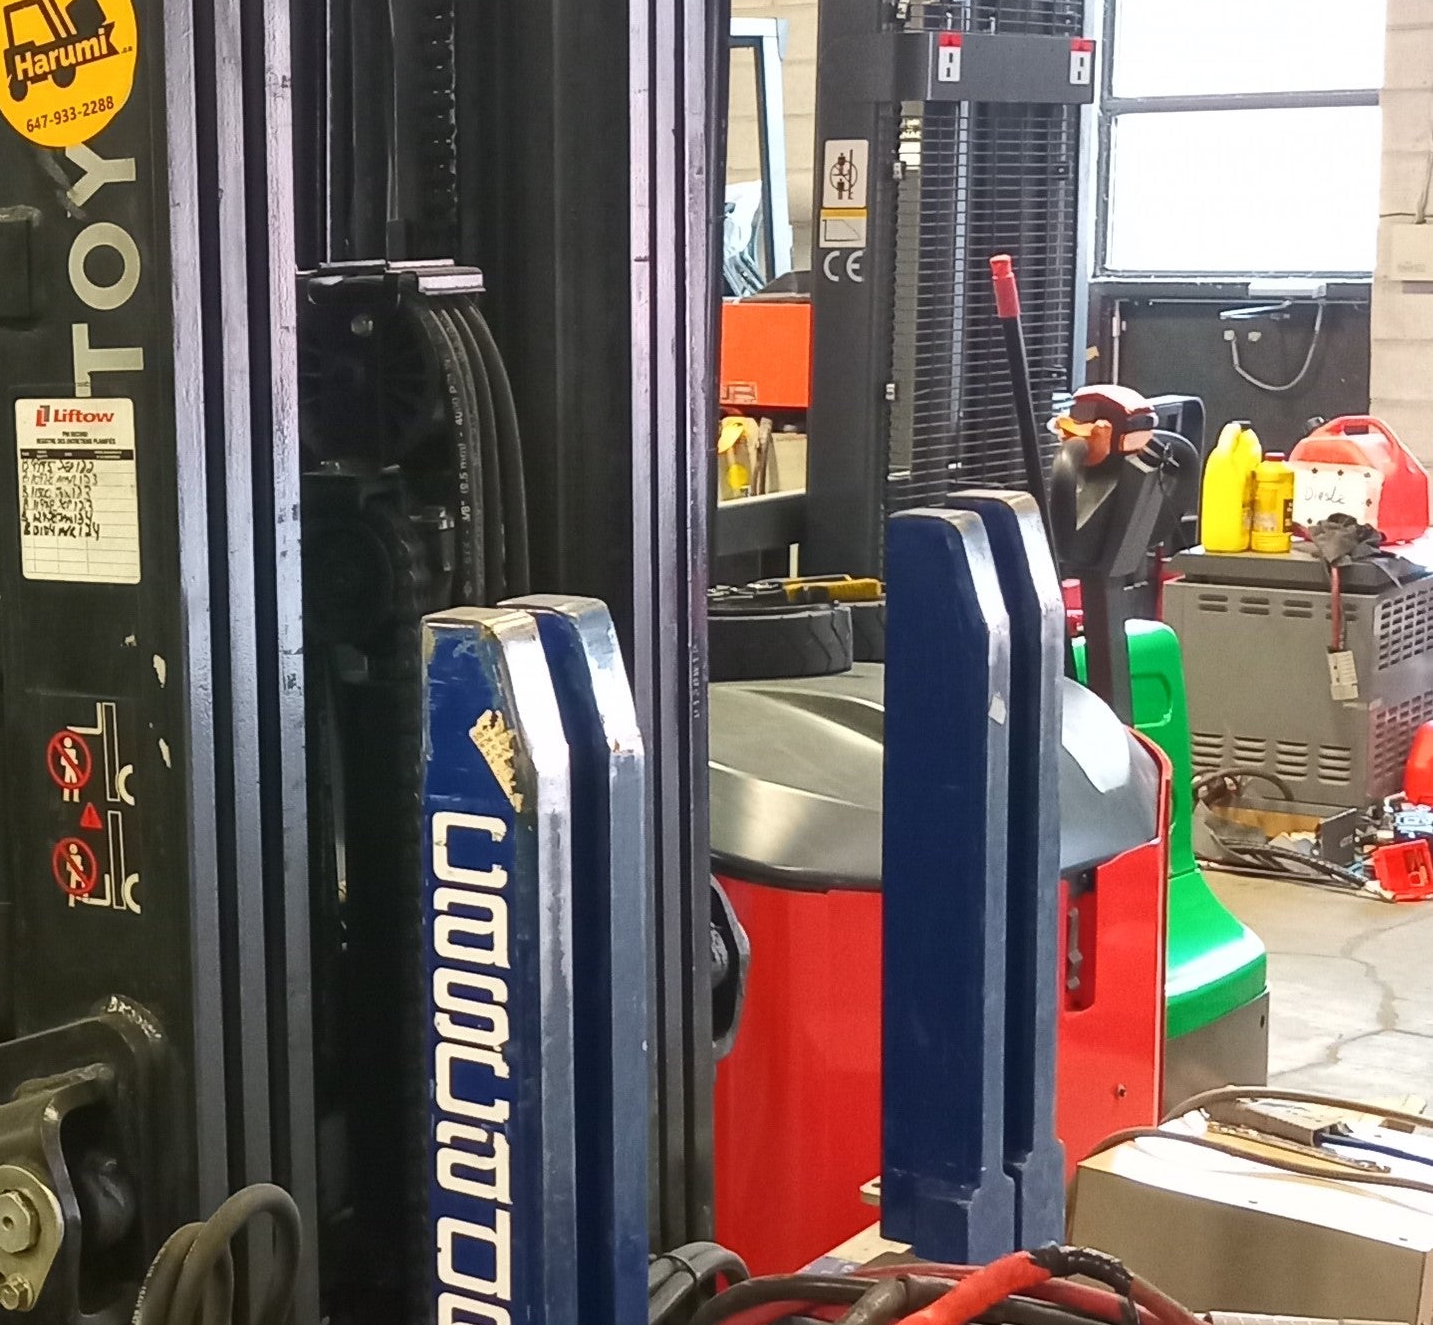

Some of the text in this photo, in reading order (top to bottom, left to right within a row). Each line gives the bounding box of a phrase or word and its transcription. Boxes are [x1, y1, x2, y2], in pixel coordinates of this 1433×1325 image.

[14, 27, 108, 81] Harumi
[26, 96, 114, 133] 647-933-2288
[823, 250, 864, 282] CE
[54, 409, 115, 423] Liftow
